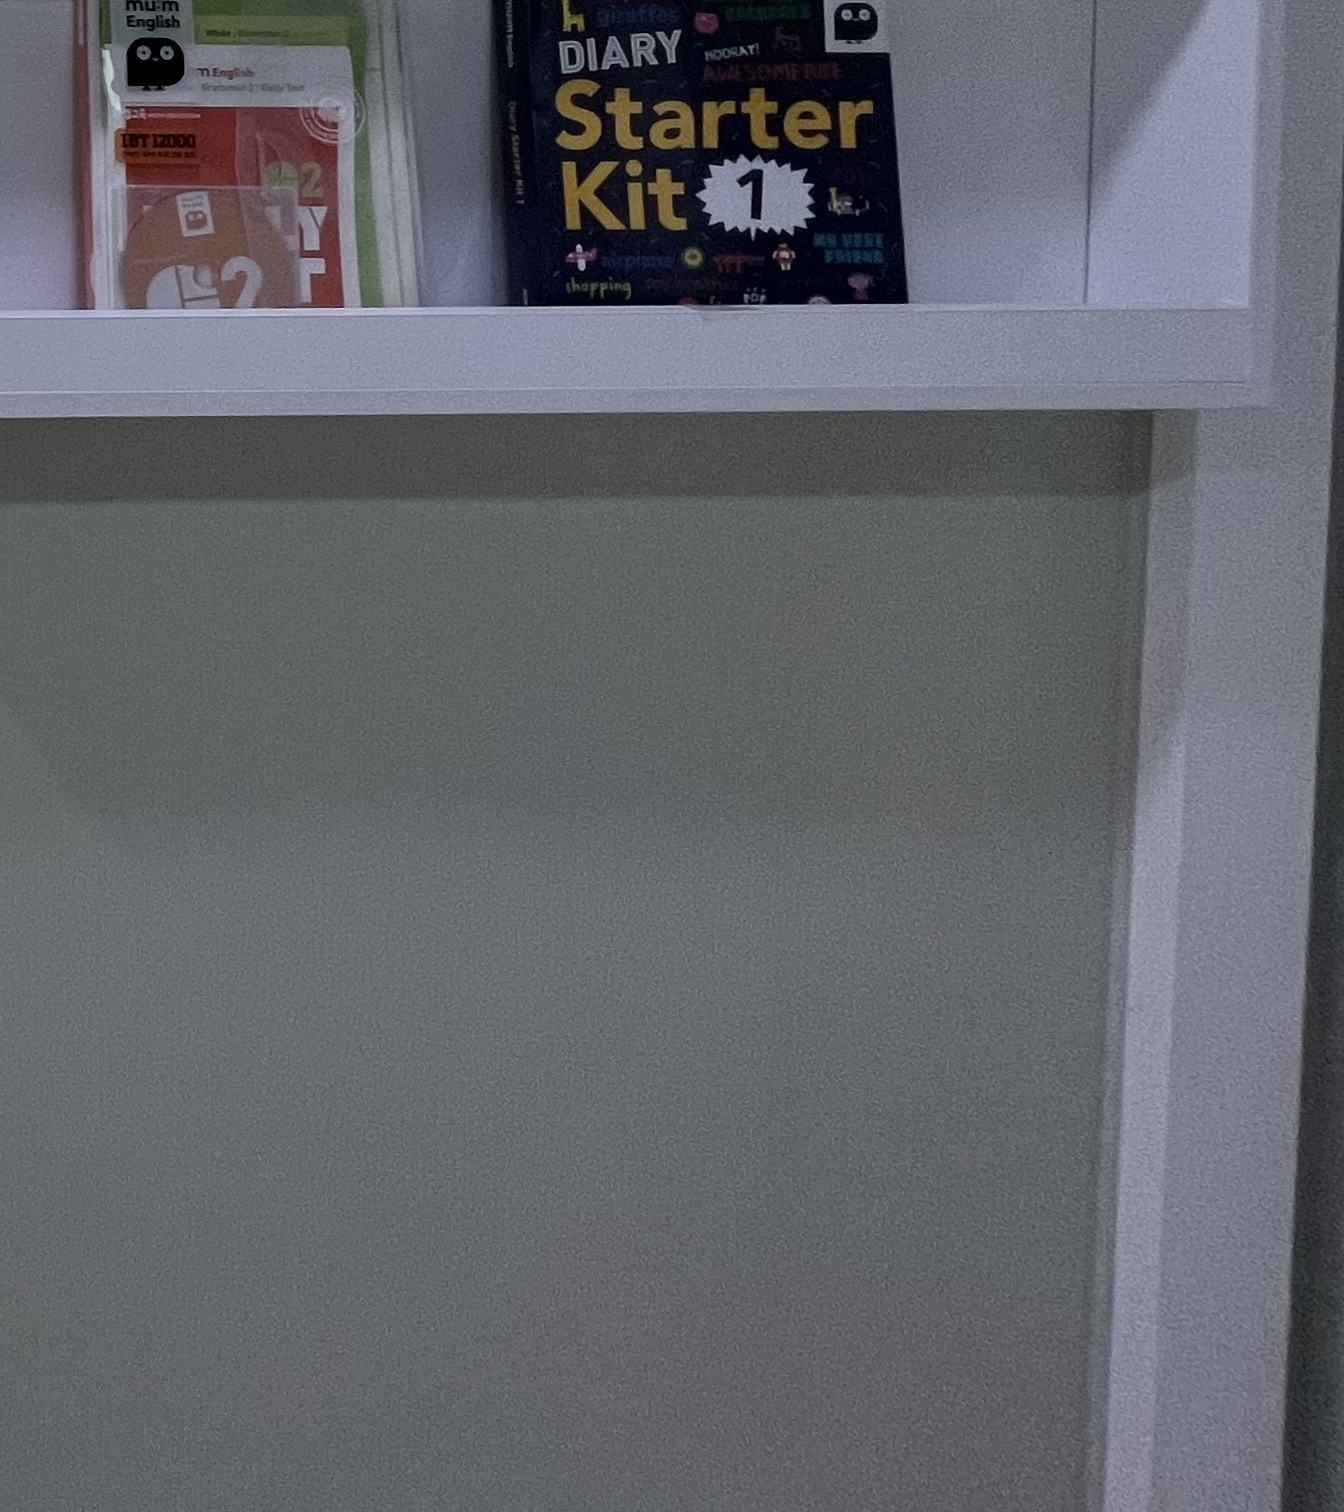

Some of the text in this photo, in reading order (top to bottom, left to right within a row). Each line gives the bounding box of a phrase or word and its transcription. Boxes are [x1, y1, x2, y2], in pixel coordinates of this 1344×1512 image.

[126, 15, 181, 32] English
[557, 29, 683, 75] DIARY
[554, 79, 875, 151] Starter
[120, 133, 196, 148] IBT 12000
[561, 159, 764, 231] Kit 1
[565, 276, 633, 301] shopping
